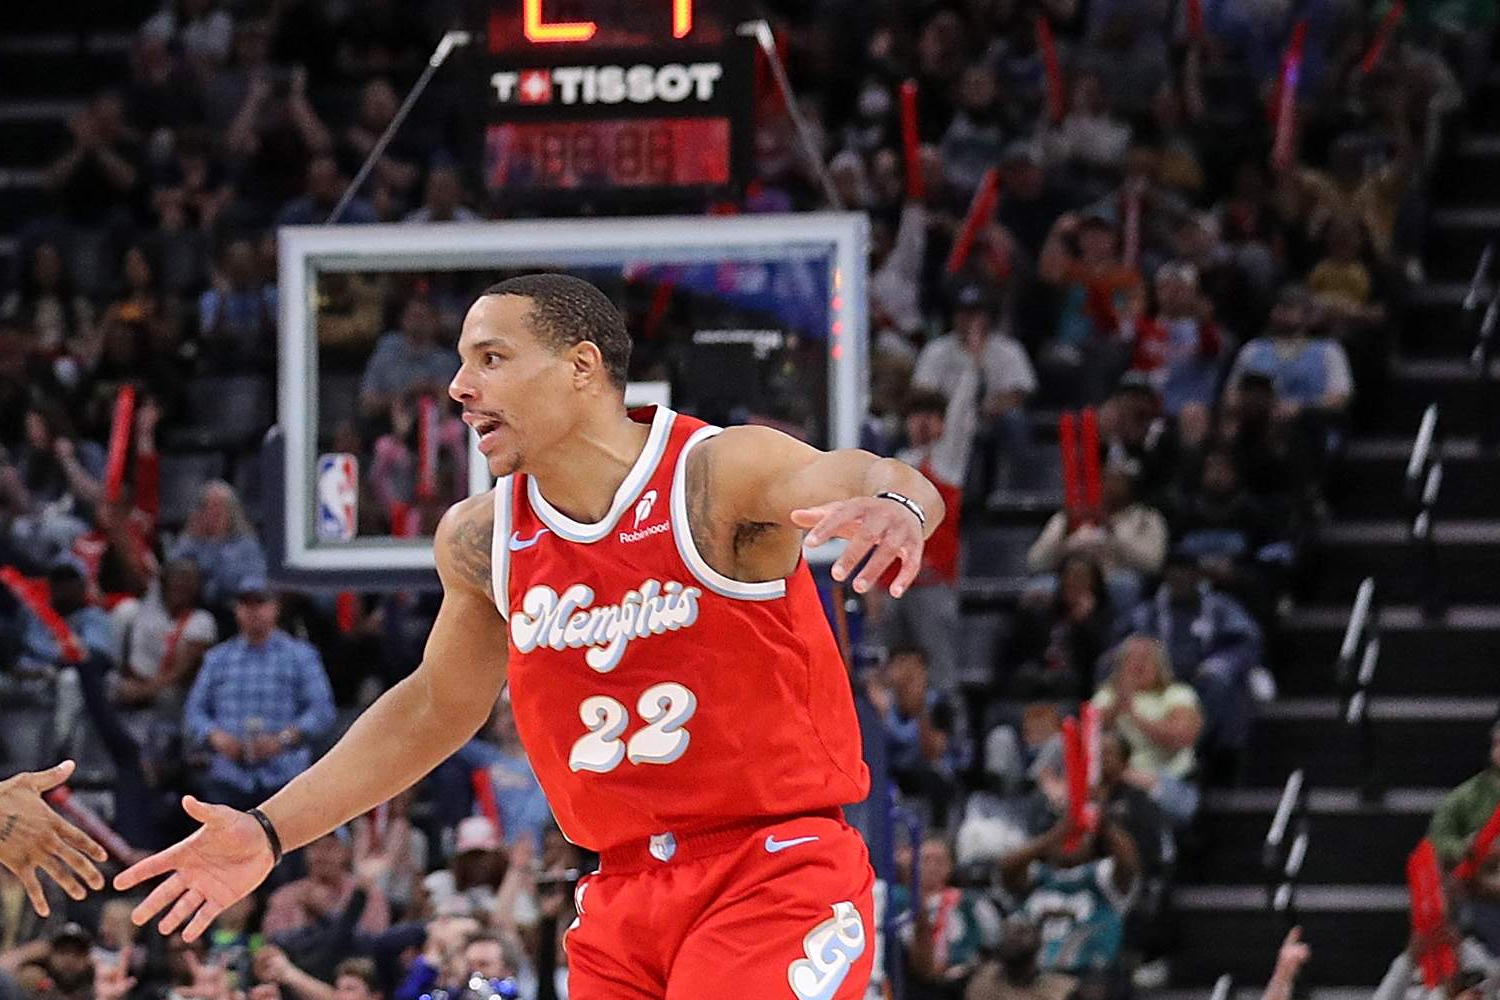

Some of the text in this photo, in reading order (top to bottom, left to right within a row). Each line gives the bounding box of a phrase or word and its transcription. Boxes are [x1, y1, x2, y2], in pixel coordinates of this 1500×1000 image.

[552, 62, 723, 104] TISSOT
[619, 520, 670, 544] Robinhood
[510, 578, 703, 673] Memphis
[568, 681, 698, 774] 22
